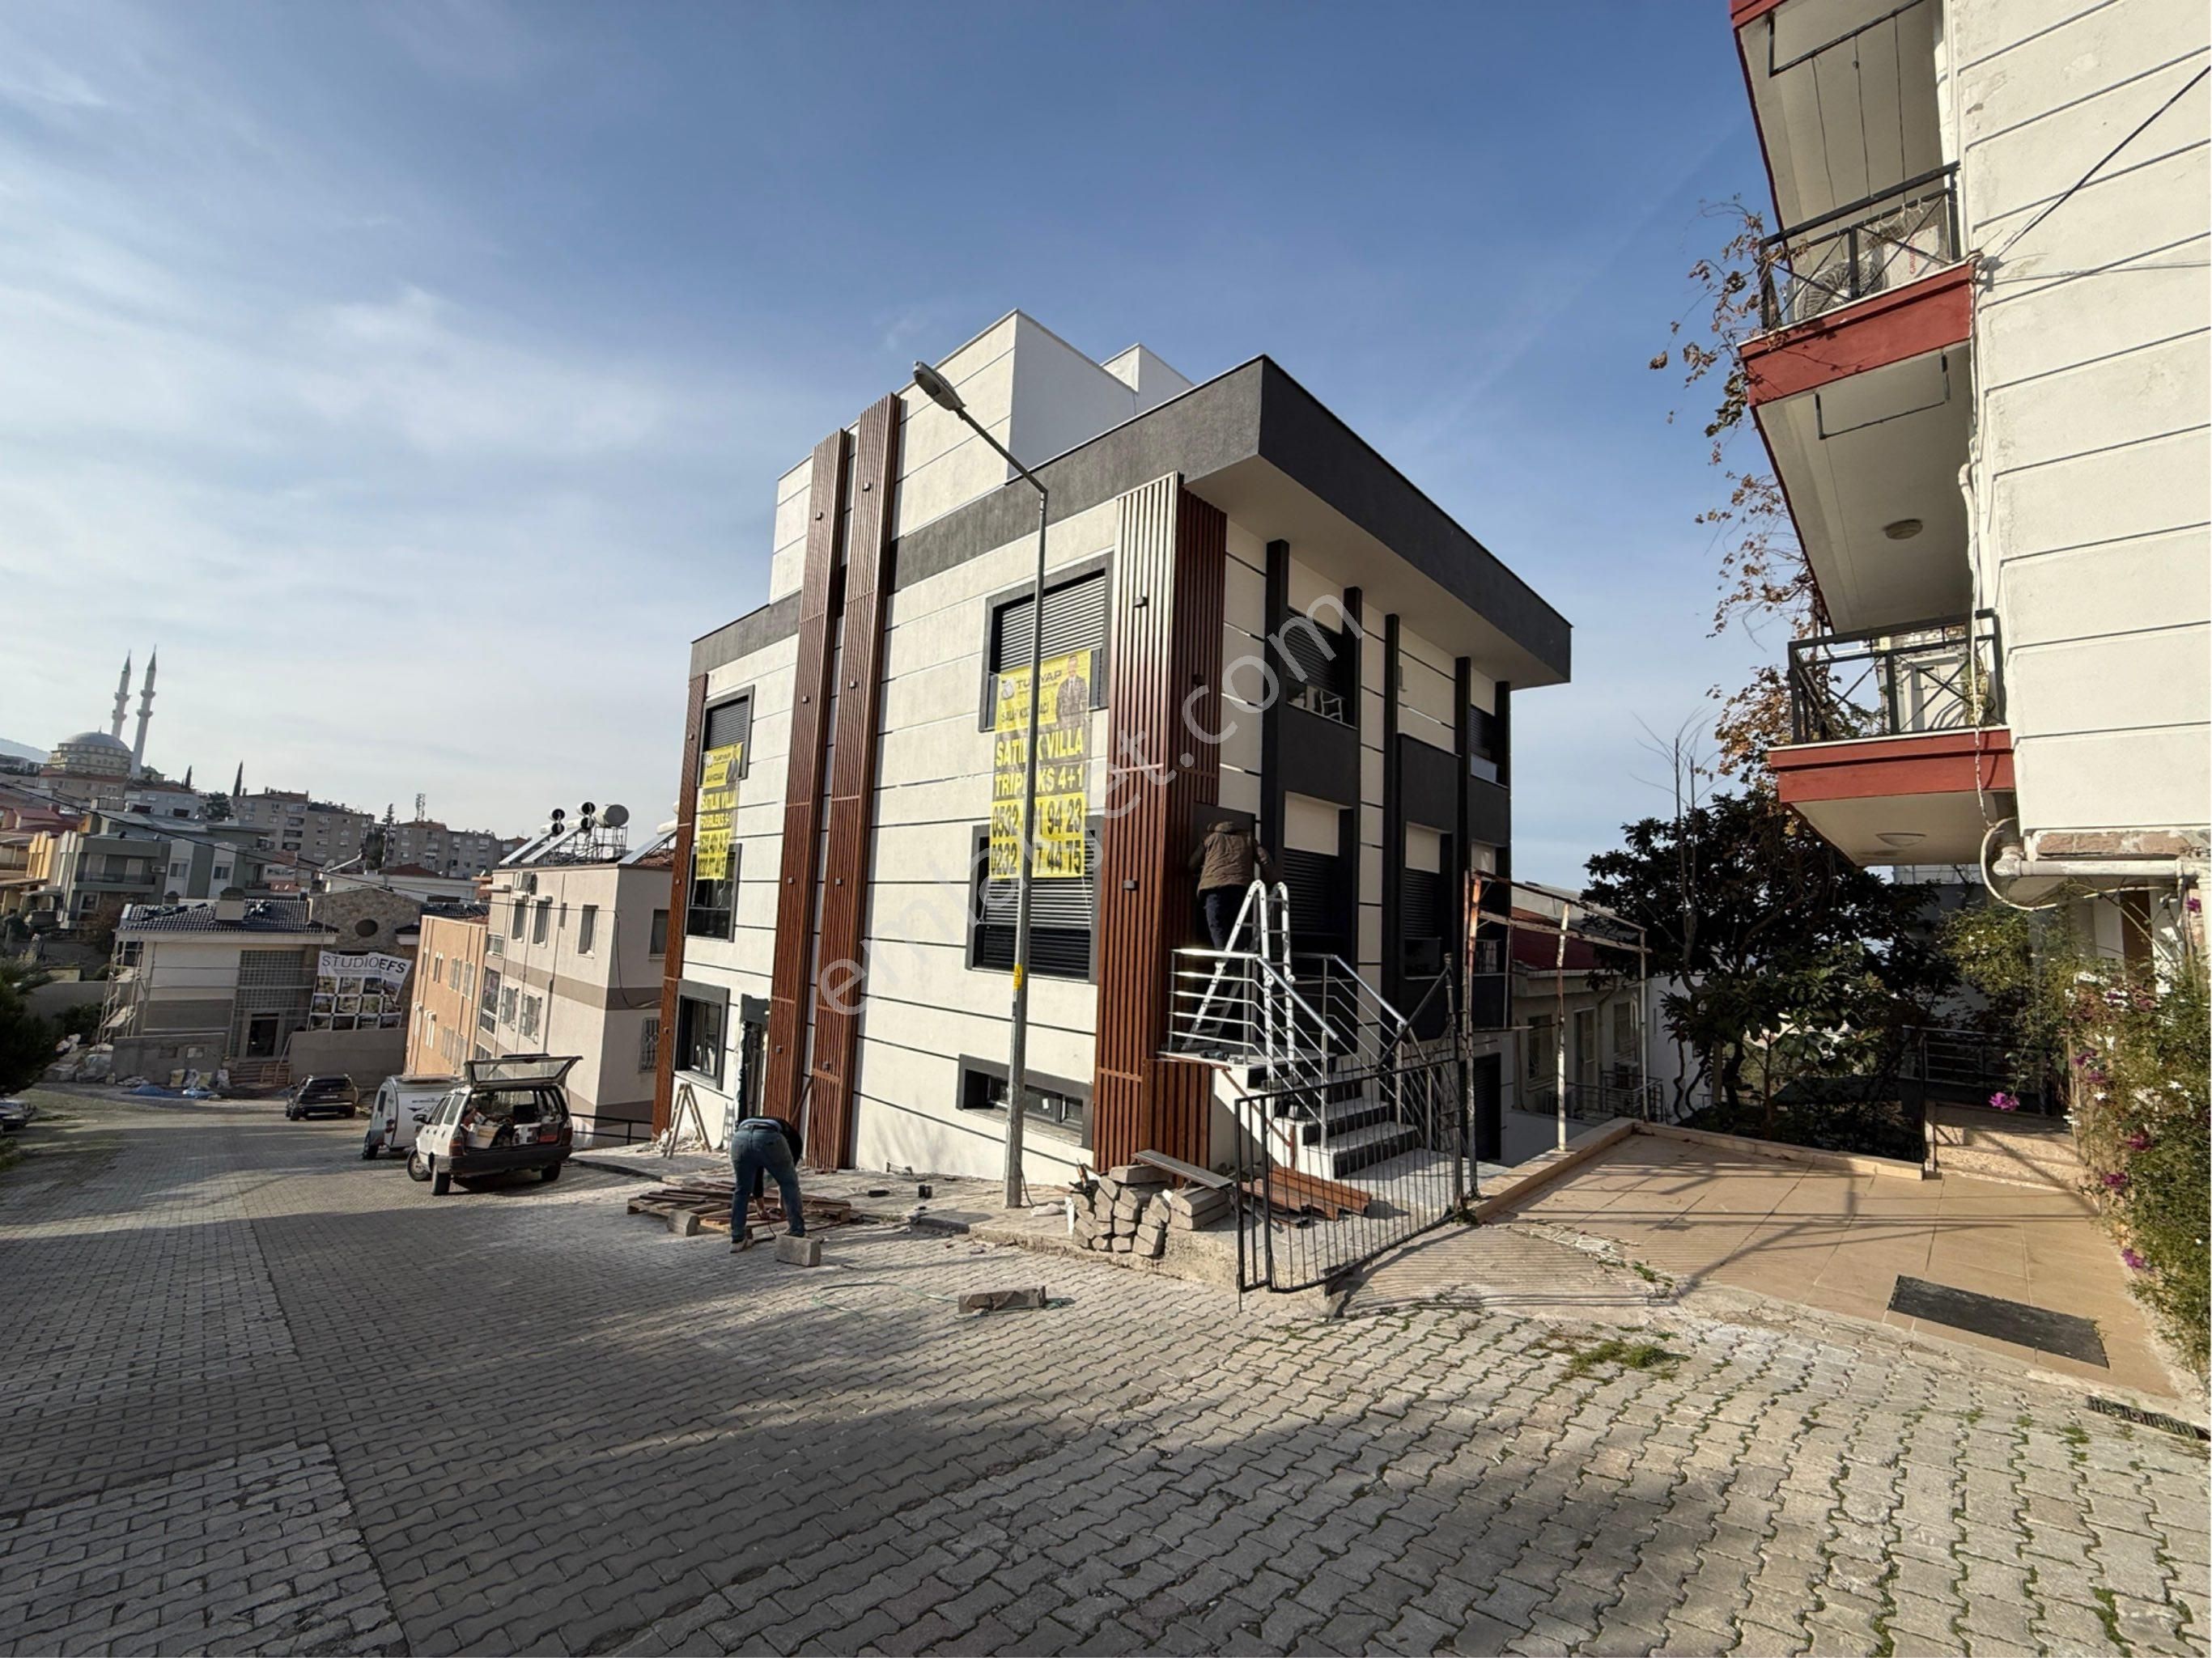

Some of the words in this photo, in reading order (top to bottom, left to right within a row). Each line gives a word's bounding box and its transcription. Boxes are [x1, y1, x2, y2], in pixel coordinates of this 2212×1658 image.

[1016, 670, 1062, 689] TUYAP
[996, 735, 1044, 767] SATILK
[1058, 763, 1083, 789] 4+1
[991, 804, 1018, 837] 0532
[1047, 800, 1062, 835] 94
[1066, 797, 1082, 833] 23
[991, 842, 1017, 876] 0232
[1047, 841, 1062, 873] 44
[1066, 839, 1081, 874] 75
[322, 956, 406, 973] STUDIOEFS
